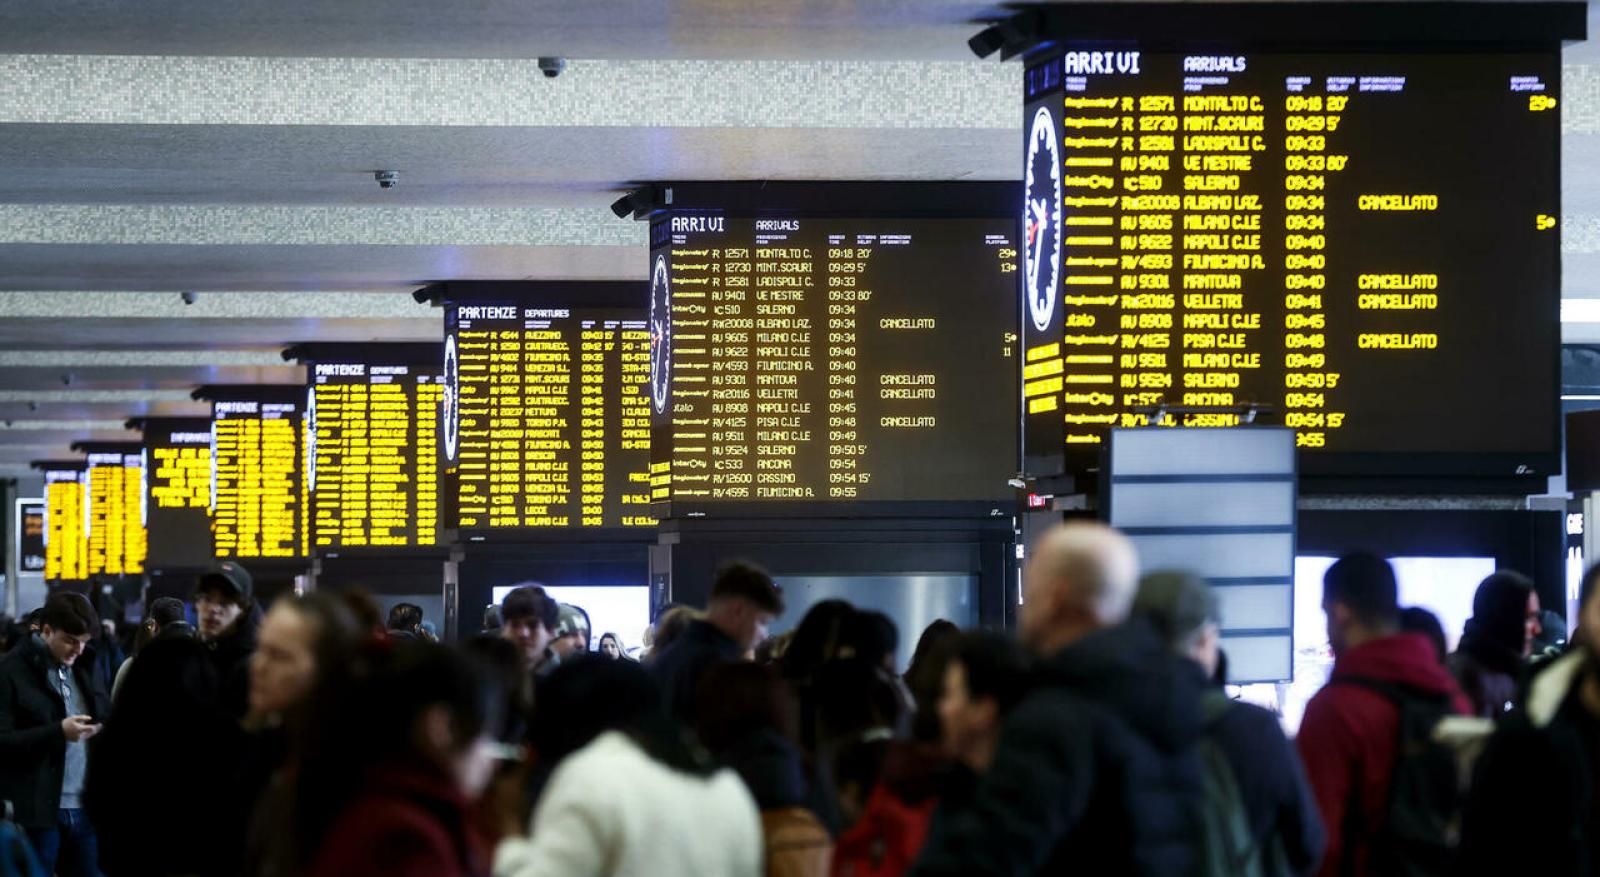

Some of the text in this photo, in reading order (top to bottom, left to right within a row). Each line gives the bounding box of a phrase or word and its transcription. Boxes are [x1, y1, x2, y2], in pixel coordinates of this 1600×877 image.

[1065, 52, 1246, 74] ARRIVI ARRIVALS
[1184, 96, 1248, 111] MONTALTO
[1250, 96, 1264, 111] C.
[1286, 96, 1322, 111] 09:18
[1286, 116, 1325, 131] 09:29
[1252, 135, 1266, 151] C.
[1286, 135, 1325, 151] 09:33
[1203, 155, 1252, 171] MESTRE
[1286, 155, 1325, 171] 09:33
[1184, 175, 1325, 190] SALERNO 09:34
[1183, 195, 1438, 210] ALBANO LAZ. 09:34 CANCELLATO
[672, 217, 799, 232] ARRIVI ARRIVALS
[1184, 214, 1547, 230] MILANO C.LE 09:34 5
[1184, 234, 1325, 250] NAPOLI C.LE 09:40
[725, 248, 749, 258] 12571
[756, 248, 801, 258] MONTALTO
[803, 248, 812, 258] C.
[828, 248, 853, 258] 09:18
[998, 248, 1011, 258] 29
[725, 262, 751, 273] 12730
[756, 262, 812, 273] MINT.SCAURI
[828, 262, 855, 273] 09:29
[1000, 262, 1011, 273] 13
[1286, 254, 1325, 270] 09:40
[725, 277, 749, 287] 12581
[756, 277, 802, 287] LADISPOLI
[805, 277, 814, 287] C.
[829, 277, 855, 287] 09:33
[1286, 274, 1325, 289] 09:40
[1358, 274, 1438, 289] CANCELLATO
[725, 291, 745, 301] 9401
[770, 291, 804, 301] MESTRE
[829, 291, 855, 301] 09:33
[1286, 293, 1322, 309] 09:41
[1358, 293, 1438, 309] CANCELLATO
[458, 306, 570, 319] PARTENZE DEPARTURES
[725, 305, 740, 315] 510
[757, 305, 795, 315] SALERNO
[829, 305, 855, 315] 09:34
[756, 319, 935, 329] ALBANO LAZ. 09:34 CANCELLATO
[1183, 313, 1325, 329] NAPOLI C.LE 09:45
[725, 333, 1011, 343] 9605 MILANO C.LE 09:34 5
[1183, 333, 1437, 348] PISA C.LE 09:48 CANCELLATO
[725, 347, 1010, 357] 9622 NAPOLI C.LE 09:40 11
[726, 361, 856, 371] 4593 FIUMICINO A. 09:40
[1183, 353, 1325, 368] MILANO C.LE 09:49
[316, 364, 364, 376] PARTENZE
[725, 375, 935, 385] 9301 MANTOVA 09:40 CANCELLATO
[1183, 372, 1240, 388] SALERNO
[1286, 372, 1325, 388] 09:50
[757, 389, 935, 399] VELLETRI 09:41 CANCELLATO
[1286, 392, 1324, 408] 09:54
[725, 403, 748, 413] 8908
[757, 403, 788, 413] NAPOLI
[791, 403, 810, 413] C.LE
[830, 403, 856, 413] 09:45
[726, 417, 935, 427] 4125 PISA C.LE 09:48 CANCELLATO
[1286, 412, 1324, 427] 09:54
[725, 431, 856, 441] 9511 MILANO C.LE 09:49
[725, 445, 748, 455] 9524
[757, 445, 796, 455] SALERNO
[830, 445, 856, 455] 09:50
[725, 459, 743, 469] 533
[757, 459, 792, 469] ANCONA
[830, 459, 856, 469] 09:54
[726, 473, 752, 483] 12600
[757, 473, 796, 483] CASSINO
[830, 473, 856, 483] 09:54
[726, 487, 856, 498] 4595 FIUMICINO A. 09:55
